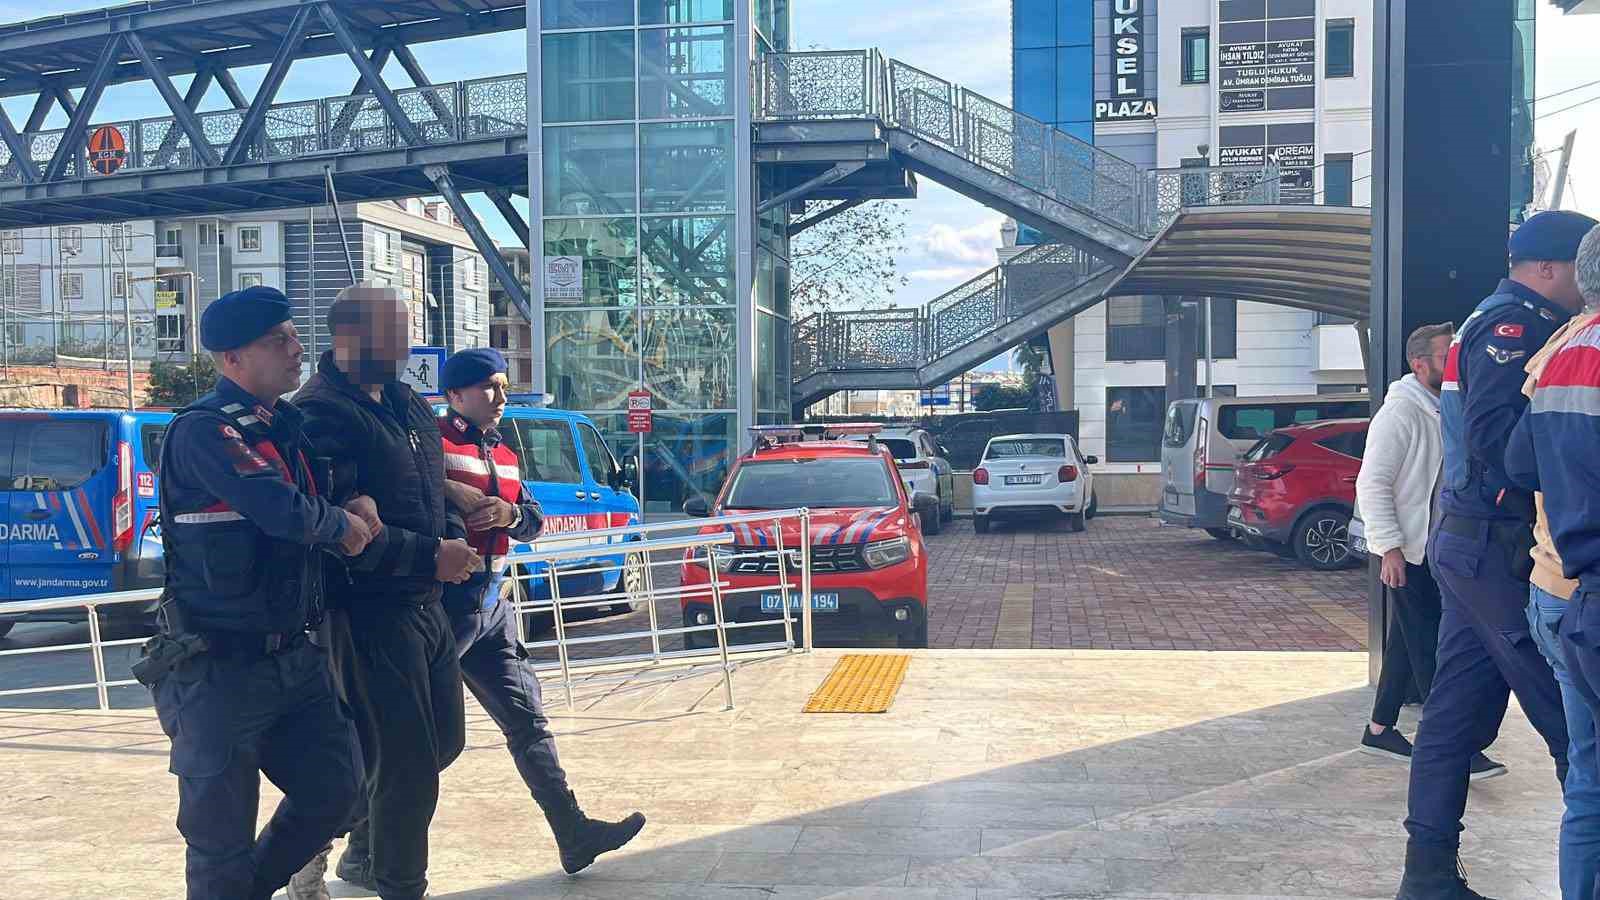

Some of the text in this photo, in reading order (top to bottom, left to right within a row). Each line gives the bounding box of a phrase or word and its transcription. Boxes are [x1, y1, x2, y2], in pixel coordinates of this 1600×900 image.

[1220, 50, 1241, 61] İHSAN
[1242, 50, 1265, 60] YILDIZ
[1267, 67, 1298, 75] HUKUK
[1290, 73, 1313, 82] TUĞLU
[1095, 101, 1156, 118] PLAZA
[1220, 148, 1264, 156] AVUKAT
[1279, 146, 1313, 155] DREAM
[138, 473, 153, 487] 112
[15, 577, 109, 588] www.jandarma.gov.tr
[766, 595, 781, 608] 07
[814, 594, 835, 609] 194
